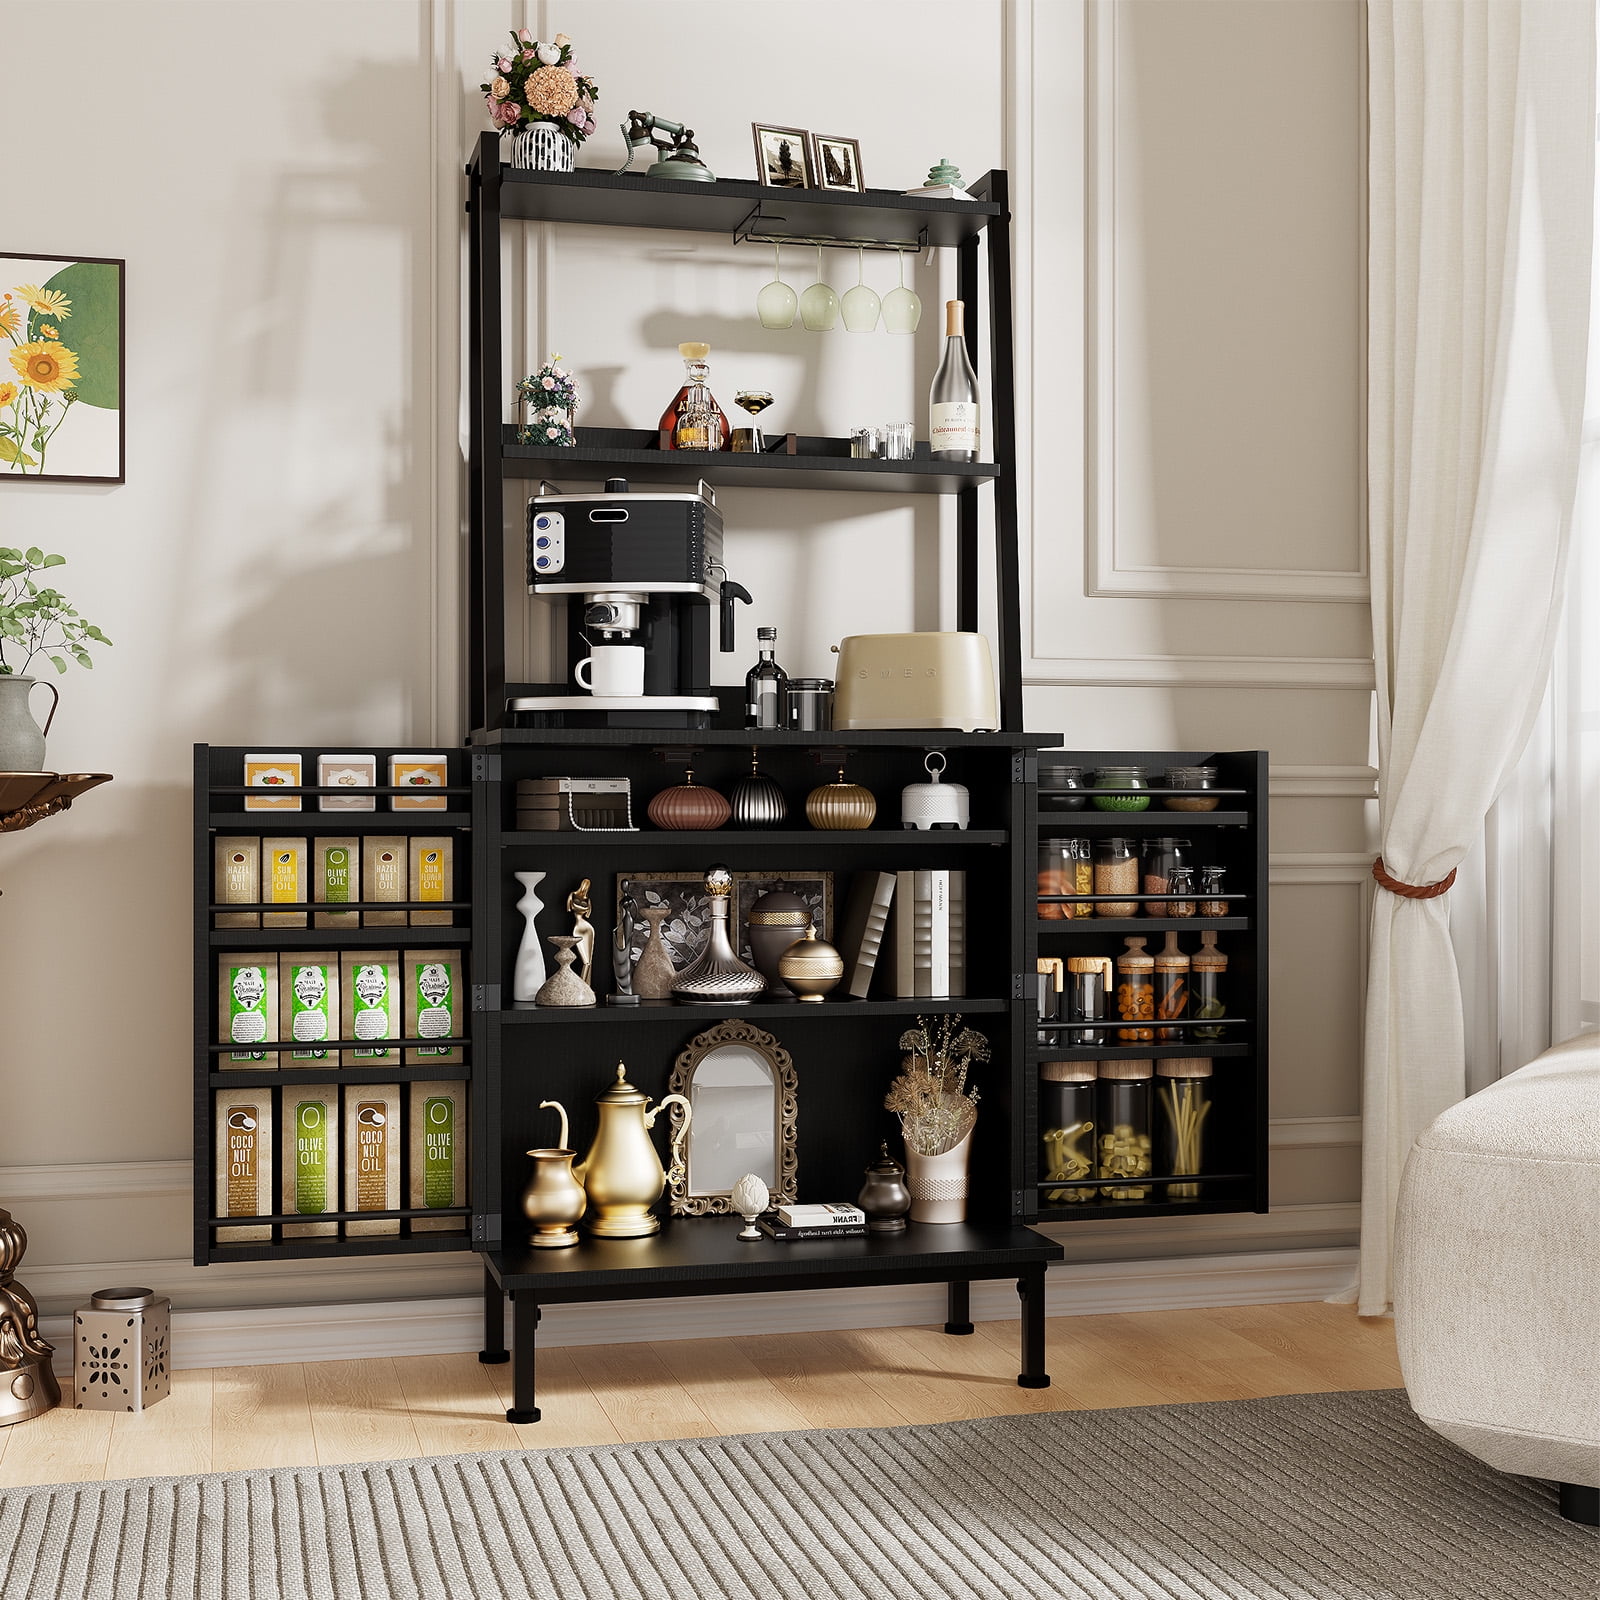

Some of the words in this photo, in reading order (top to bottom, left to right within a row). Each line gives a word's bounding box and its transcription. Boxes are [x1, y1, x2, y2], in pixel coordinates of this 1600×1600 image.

[858, 667, 937, 680] SMEG
[227, 865, 249, 874] HAZEL
[277, 866, 292, 874] SUN
[327, 868, 347, 877] OLIVE
[376, 864, 397, 873] HAZEL
[424, 865, 439, 873] SUN
[231, 874, 246, 882] NUT
[329, 877, 345, 886] OIL
[380, 873, 393, 881] NUT
[230, 882, 247, 891] OIL
[276, 882, 293, 890] OIL
[378, 881, 394, 890] OIL
[423, 881, 439, 889] OIL
[360, 1130, 383, 1144] COCO
[427, 1133, 451, 1146] OLIVE
[230, 1135, 254, 1149] COCO
[298, 1137, 323, 1151] OLIVE
[363, 1144, 380, 1157] NUT
[428, 1146, 449, 1160] OIL
[233, 1149, 251, 1162] NUT
[300, 1151, 321, 1165] OIL
[231, 1162, 253, 1177] OIL
[361, 1158, 382, 1172] OIL
